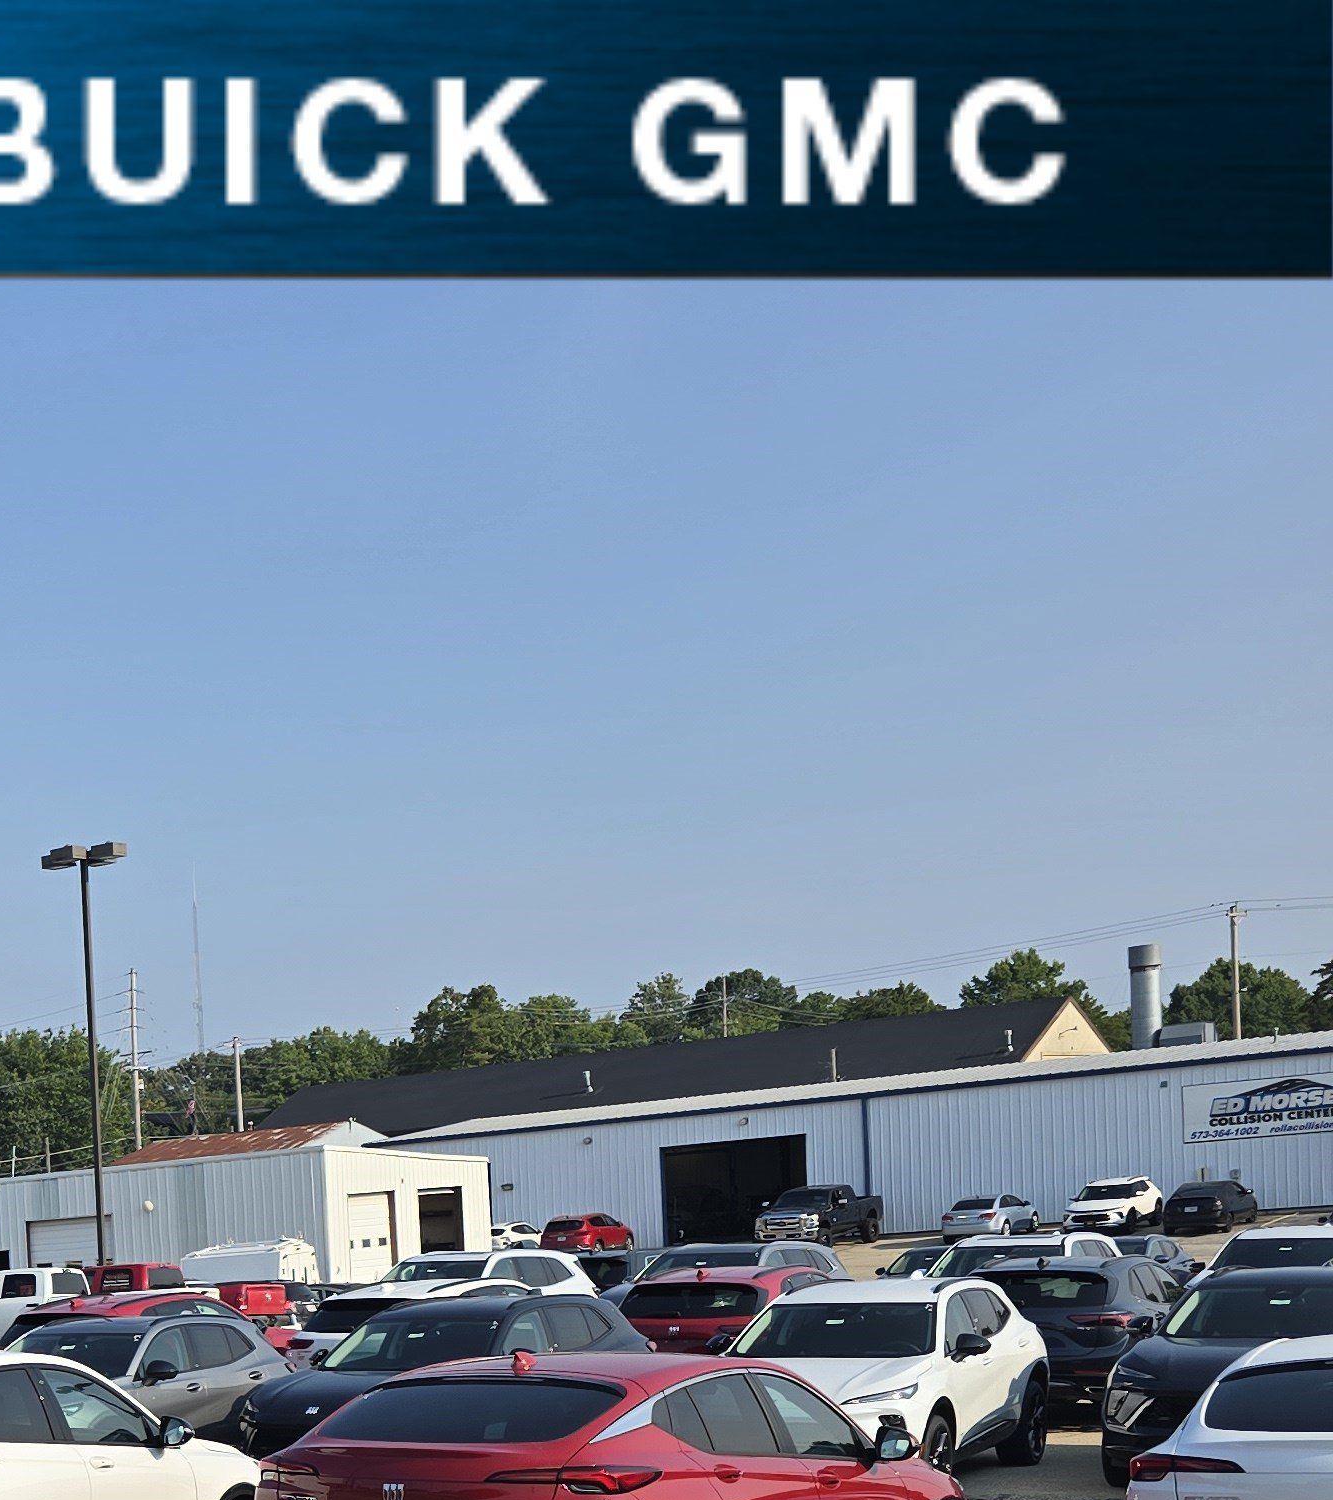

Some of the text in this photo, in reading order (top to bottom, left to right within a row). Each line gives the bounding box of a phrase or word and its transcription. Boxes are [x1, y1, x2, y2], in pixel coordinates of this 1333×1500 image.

[1213, 1088, 1333, 1114] ED MORSE
[1209, 1112, 1284, 1127] COLLISION
[1190, 1126, 1260, 1140] 573-364-1002
